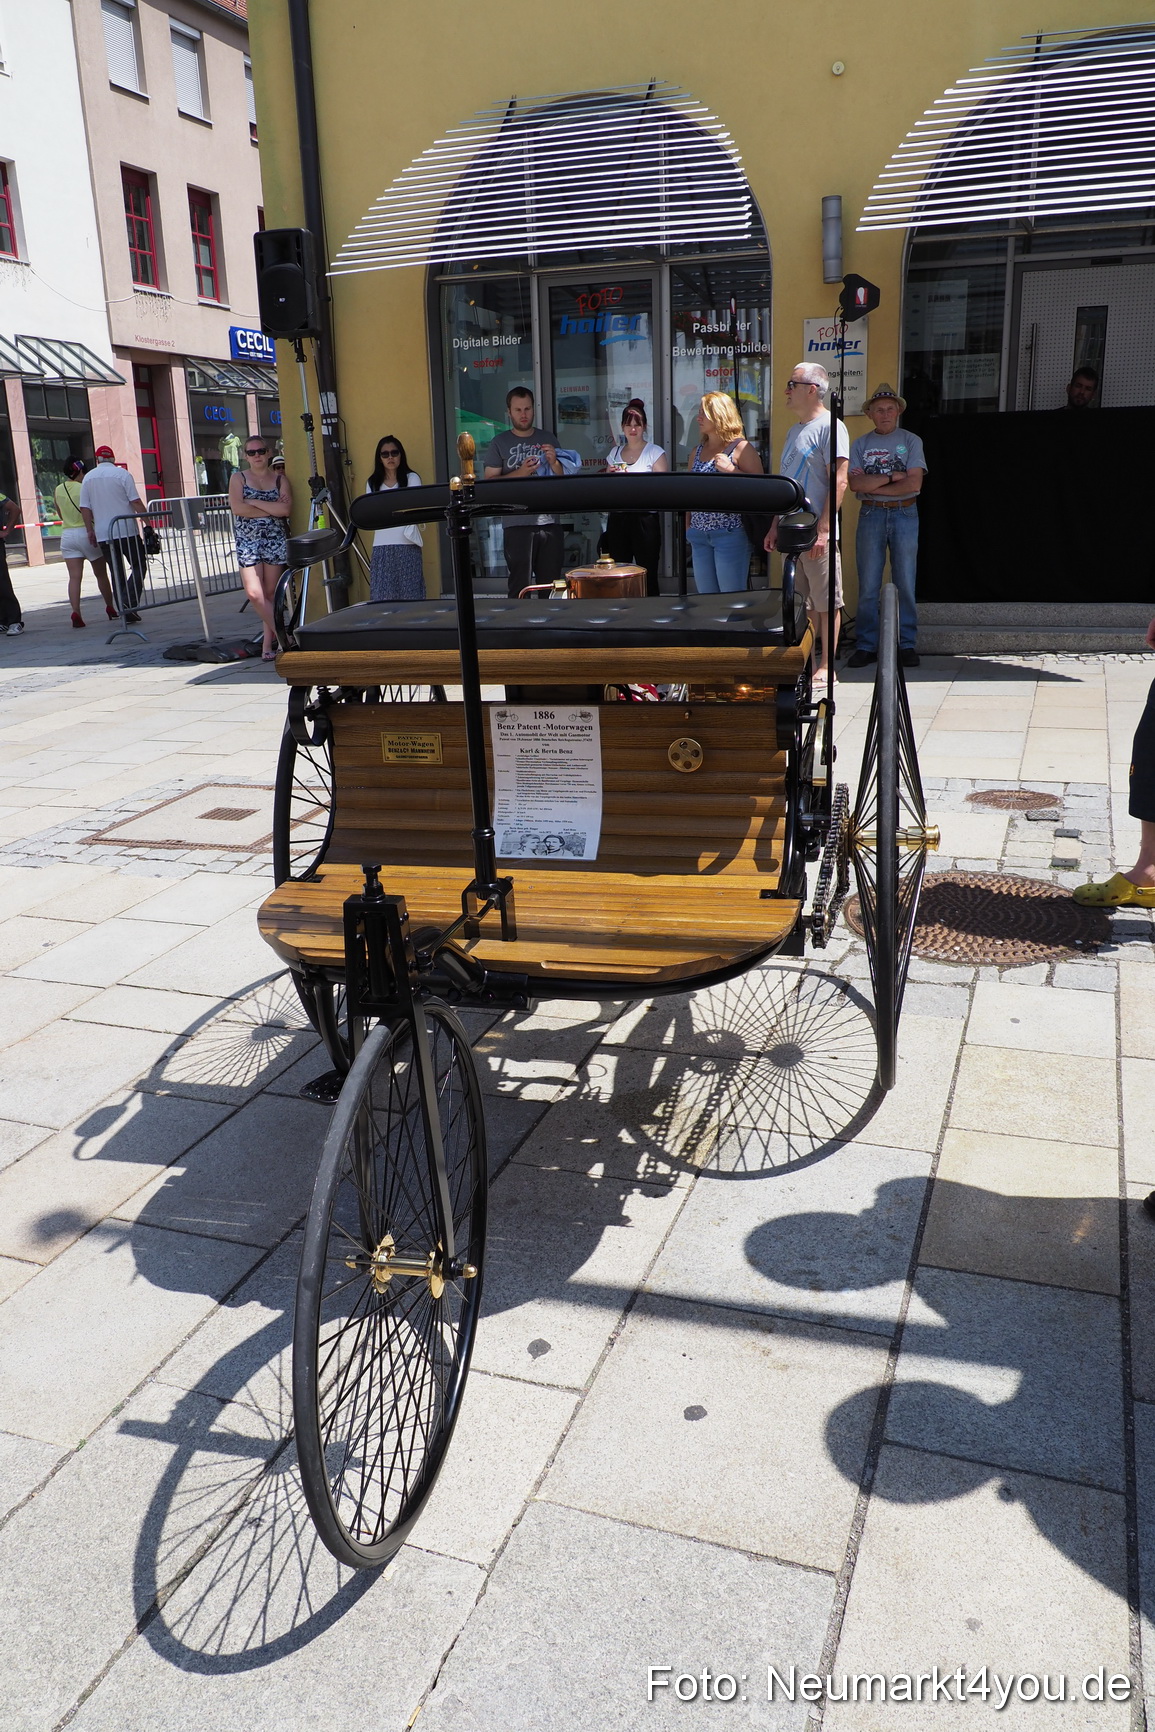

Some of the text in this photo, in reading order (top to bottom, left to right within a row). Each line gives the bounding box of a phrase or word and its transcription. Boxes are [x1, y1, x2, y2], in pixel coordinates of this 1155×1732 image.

[575, 286, 623, 316] FOTO
[560, 312, 642, 335] hailer
[692, 320, 751, 334] Passbier
[816, 323, 849, 341] FOTO
[134, 334, 176, 348] Klostergasse 2
[236, 329, 274, 352] CECIL
[452, 335, 522, 351] Digitale Bilder
[705, 366, 735, 377] sofor
[560, 385, 590, 394] LEINWAND
[204, 405, 236, 423] CECIL
[592, 434, 615, 446] FOTO
[533, 710, 556, 719] 1886
[543, 723, 593, 732] -Motorwagen
